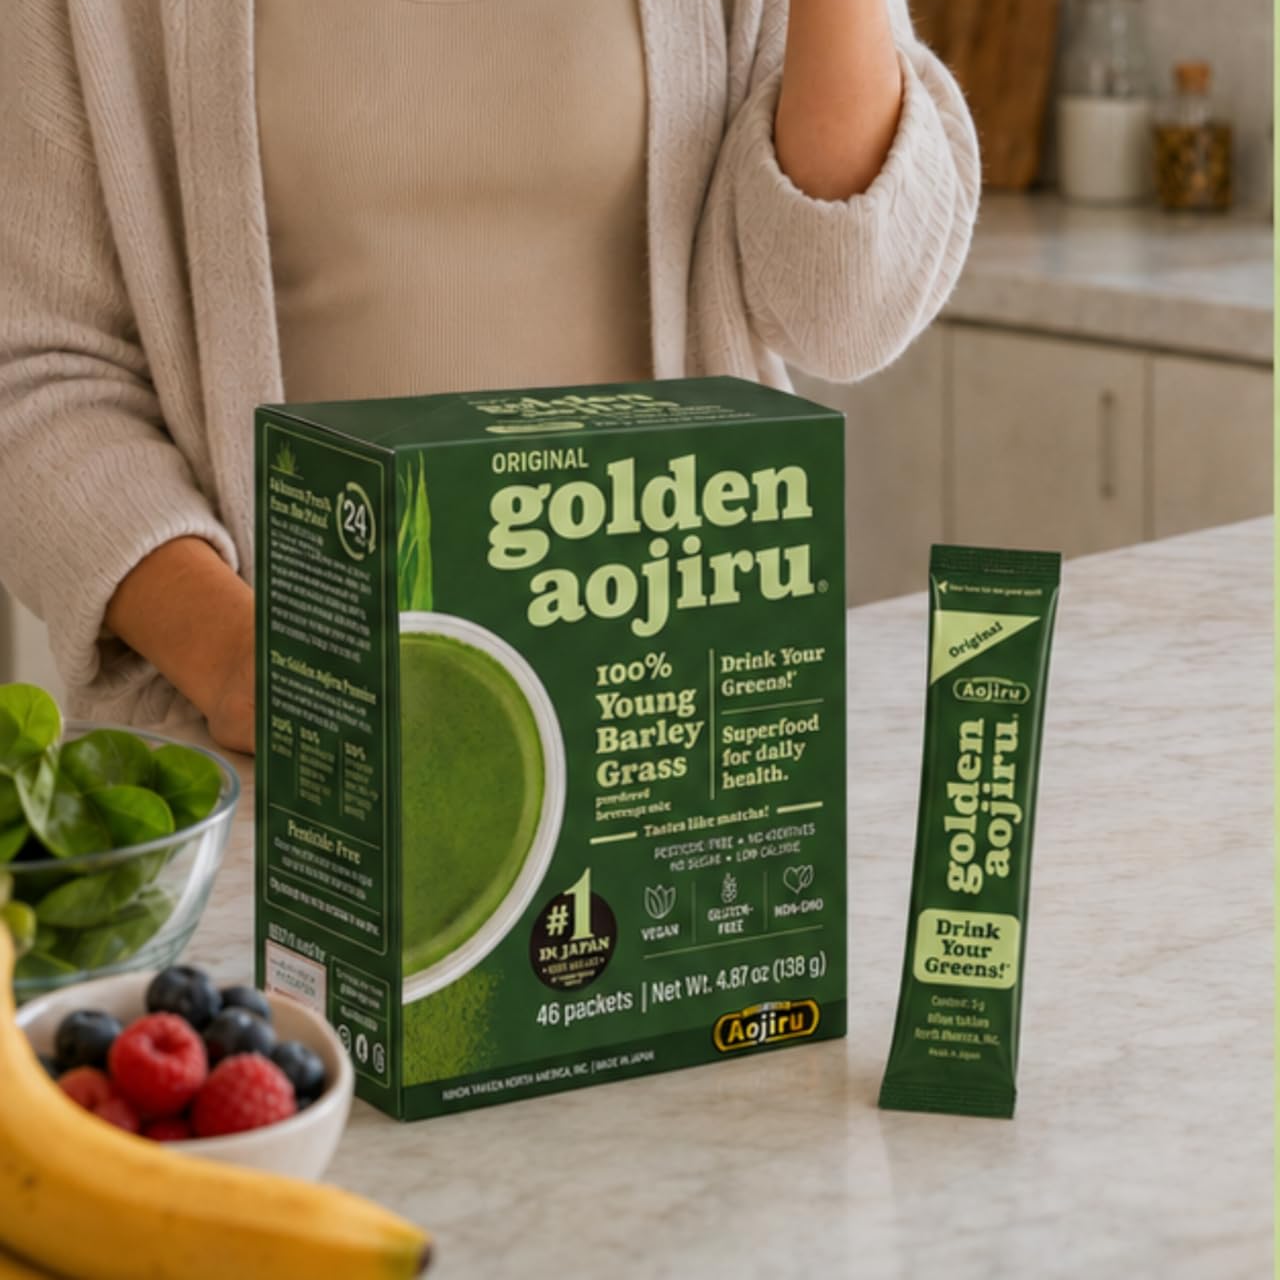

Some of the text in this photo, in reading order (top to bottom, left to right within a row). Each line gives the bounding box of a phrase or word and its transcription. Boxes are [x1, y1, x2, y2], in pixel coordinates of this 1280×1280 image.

[492, 448, 589, 474] ORIGINAL
[344, 499, 367, 539] 24
[487, 454, 813, 570] golden
[527, 535, 815, 638] aojiru
[948, 621, 1004, 658] Original
[596, 651, 673, 686] 100%
[720, 647, 826, 673] Drink Your
[595, 688, 697, 719] Young
[962, 683, 1020, 701] Aojiru
[595, 720, 704, 754] Barley
[722, 714, 820, 745] Superfood
[596, 756, 688, 788] Grass
[722, 747, 751, 768] for
[721, 764, 789, 790] health.
[944, 717, 984, 895] golden
[981, 720, 1023, 878] aojiru
[546, 867, 595, 941] #1
[936, 917, 1001, 940] Drink
[941, 938, 993, 959] Your
[536, 950, 827, 1027] 46 packets Net Wt. 4.87 oz (138 g)
[727, 1012, 804, 1043] Aojiru
